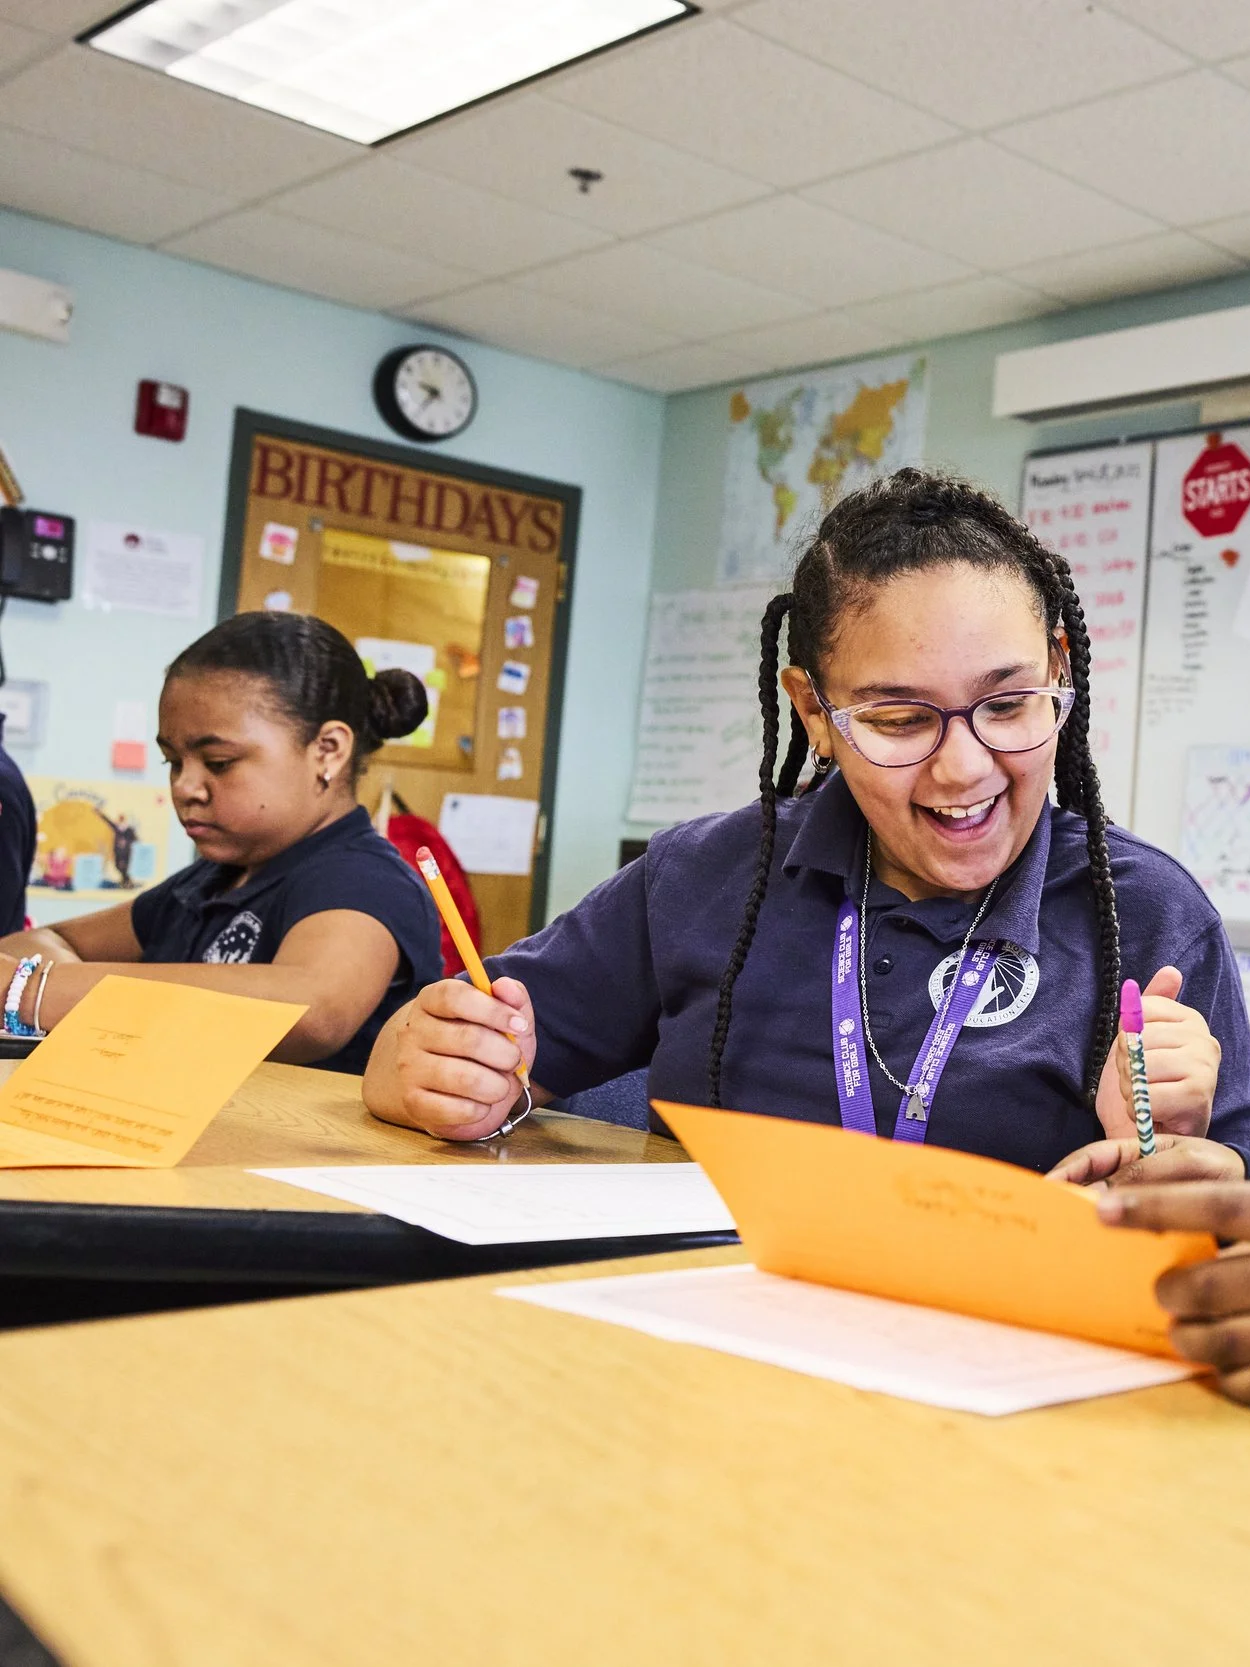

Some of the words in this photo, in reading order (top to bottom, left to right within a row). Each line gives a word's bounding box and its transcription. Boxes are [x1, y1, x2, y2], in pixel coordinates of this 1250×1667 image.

[251, 441, 562, 553] BIRTHDAYS
[1183, 468, 1250, 512] STARTS
[975, 951, 990, 971] CLUB
[840, 1036, 850, 1060] CLUB
[936, 1022, 956, 1058] SCIENCE
[849, 1042, 859, 1069] GIRLS
[842, 1059, 855, 1098] SCIENCE
[852, 1069, 862, 1088] FOR
[925, 1058, 940, 1081] CLUB
